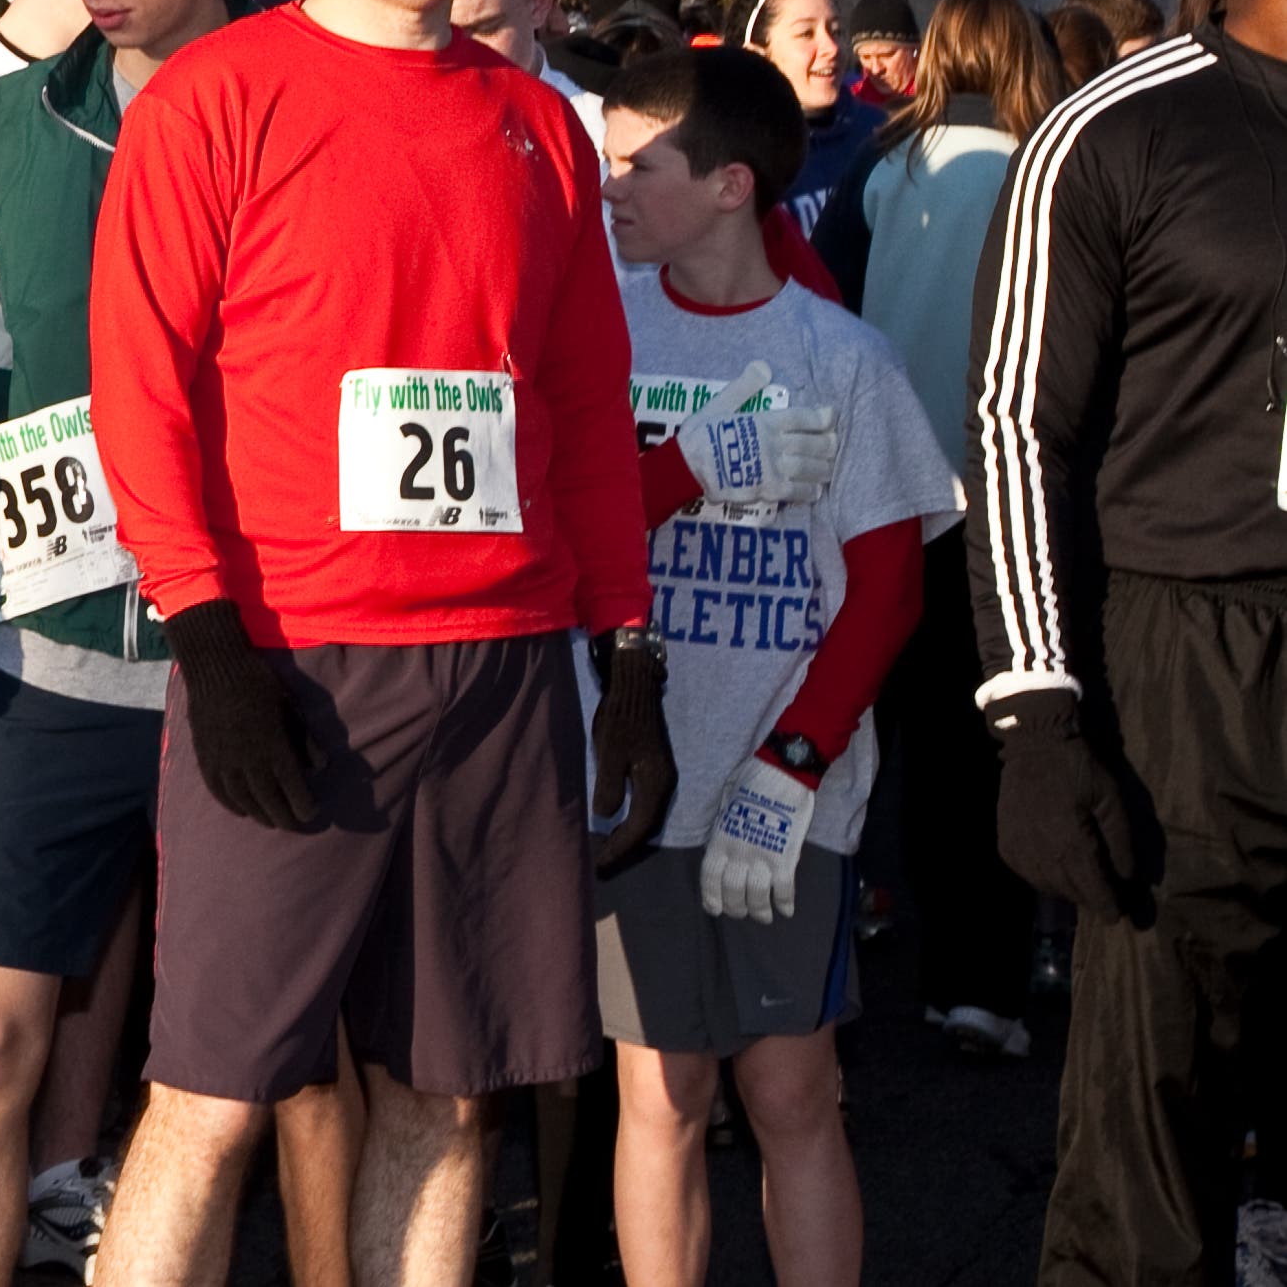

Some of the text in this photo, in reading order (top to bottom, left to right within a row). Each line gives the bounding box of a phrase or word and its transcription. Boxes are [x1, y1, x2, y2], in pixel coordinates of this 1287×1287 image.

[354, 377, 503, 417] Fly with the Owls
[647, 380, 688, 412] with
[20, 422, 48, 454] the
[50, 406, 94, 443] Owls
[399, 422, 476, 501] 26
[656, 585, 825, 652] LETICS
